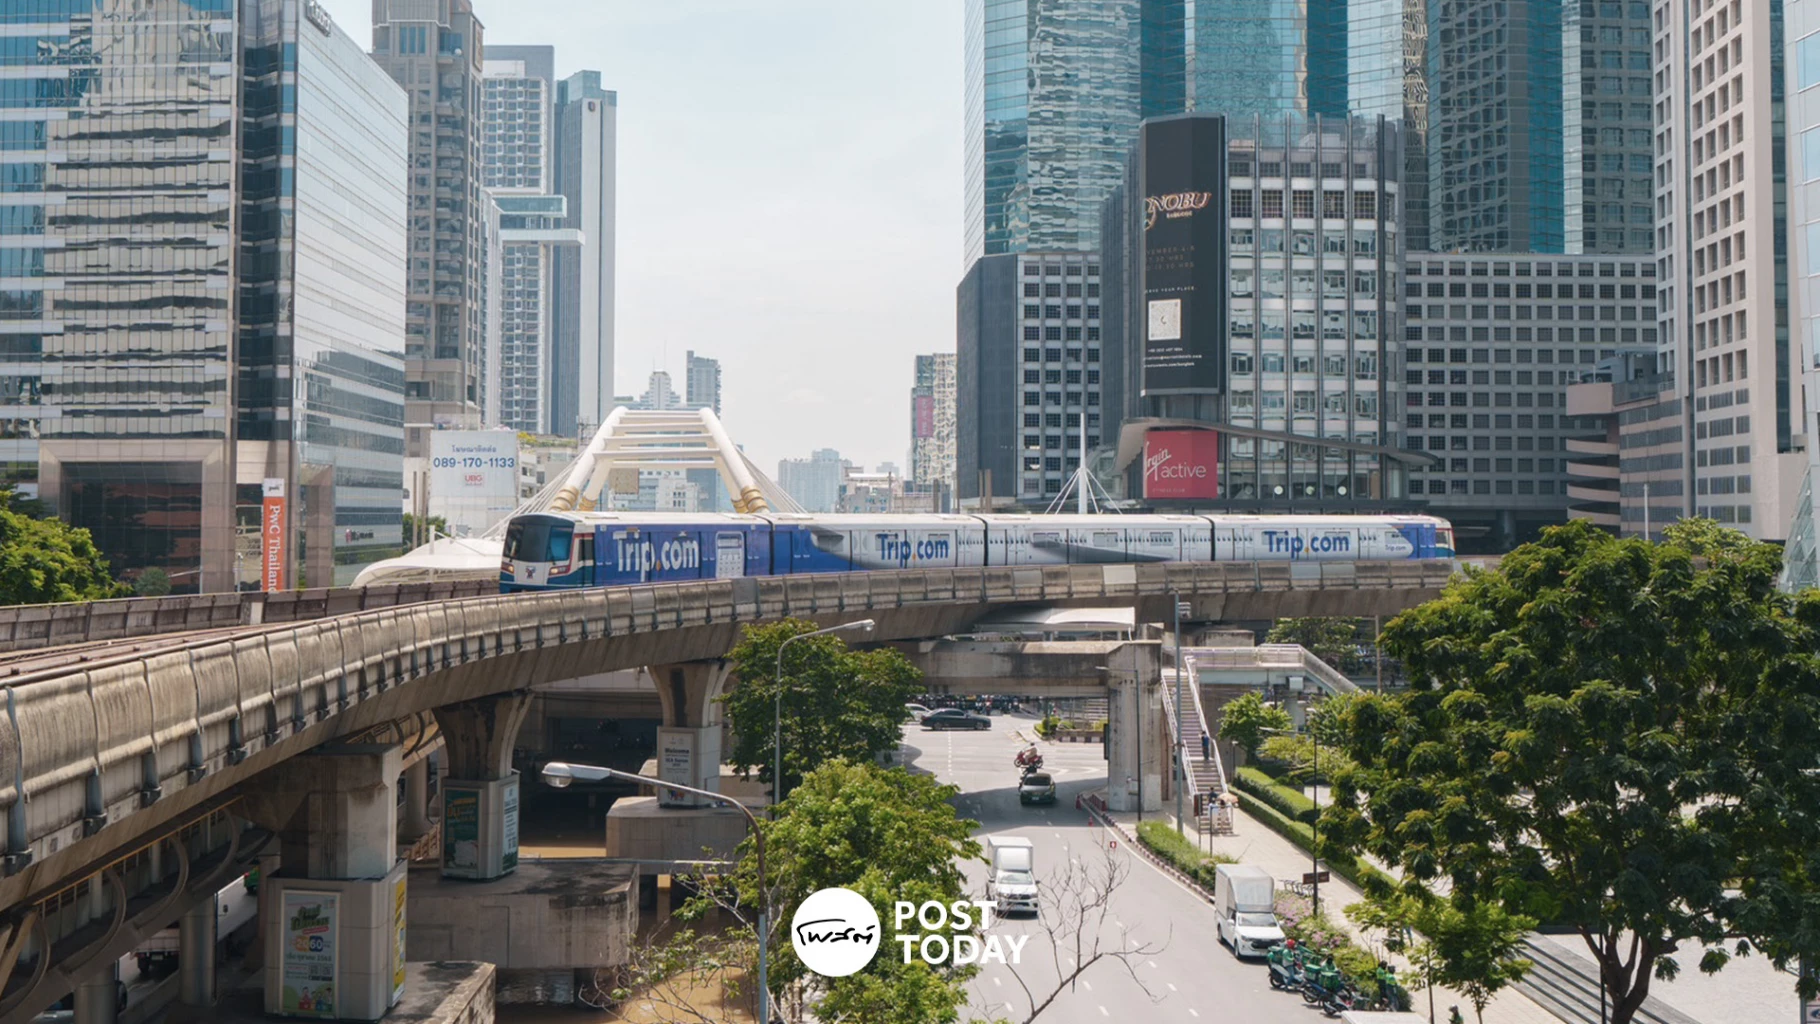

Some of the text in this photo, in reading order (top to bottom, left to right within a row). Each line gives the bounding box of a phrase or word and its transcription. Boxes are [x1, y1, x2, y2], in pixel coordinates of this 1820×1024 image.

[433, 457, 515, 468] 089-170-1133
[1160, 461, 1207, 478] active
[269, 504, 281, 534] PwC
[612, 529, 700, 583] Trip.com
[876, 532, 949, 567] Trip.com
[1263, 530, 1350, 559] Trip.com
[310, 938, 323, 950] 60
